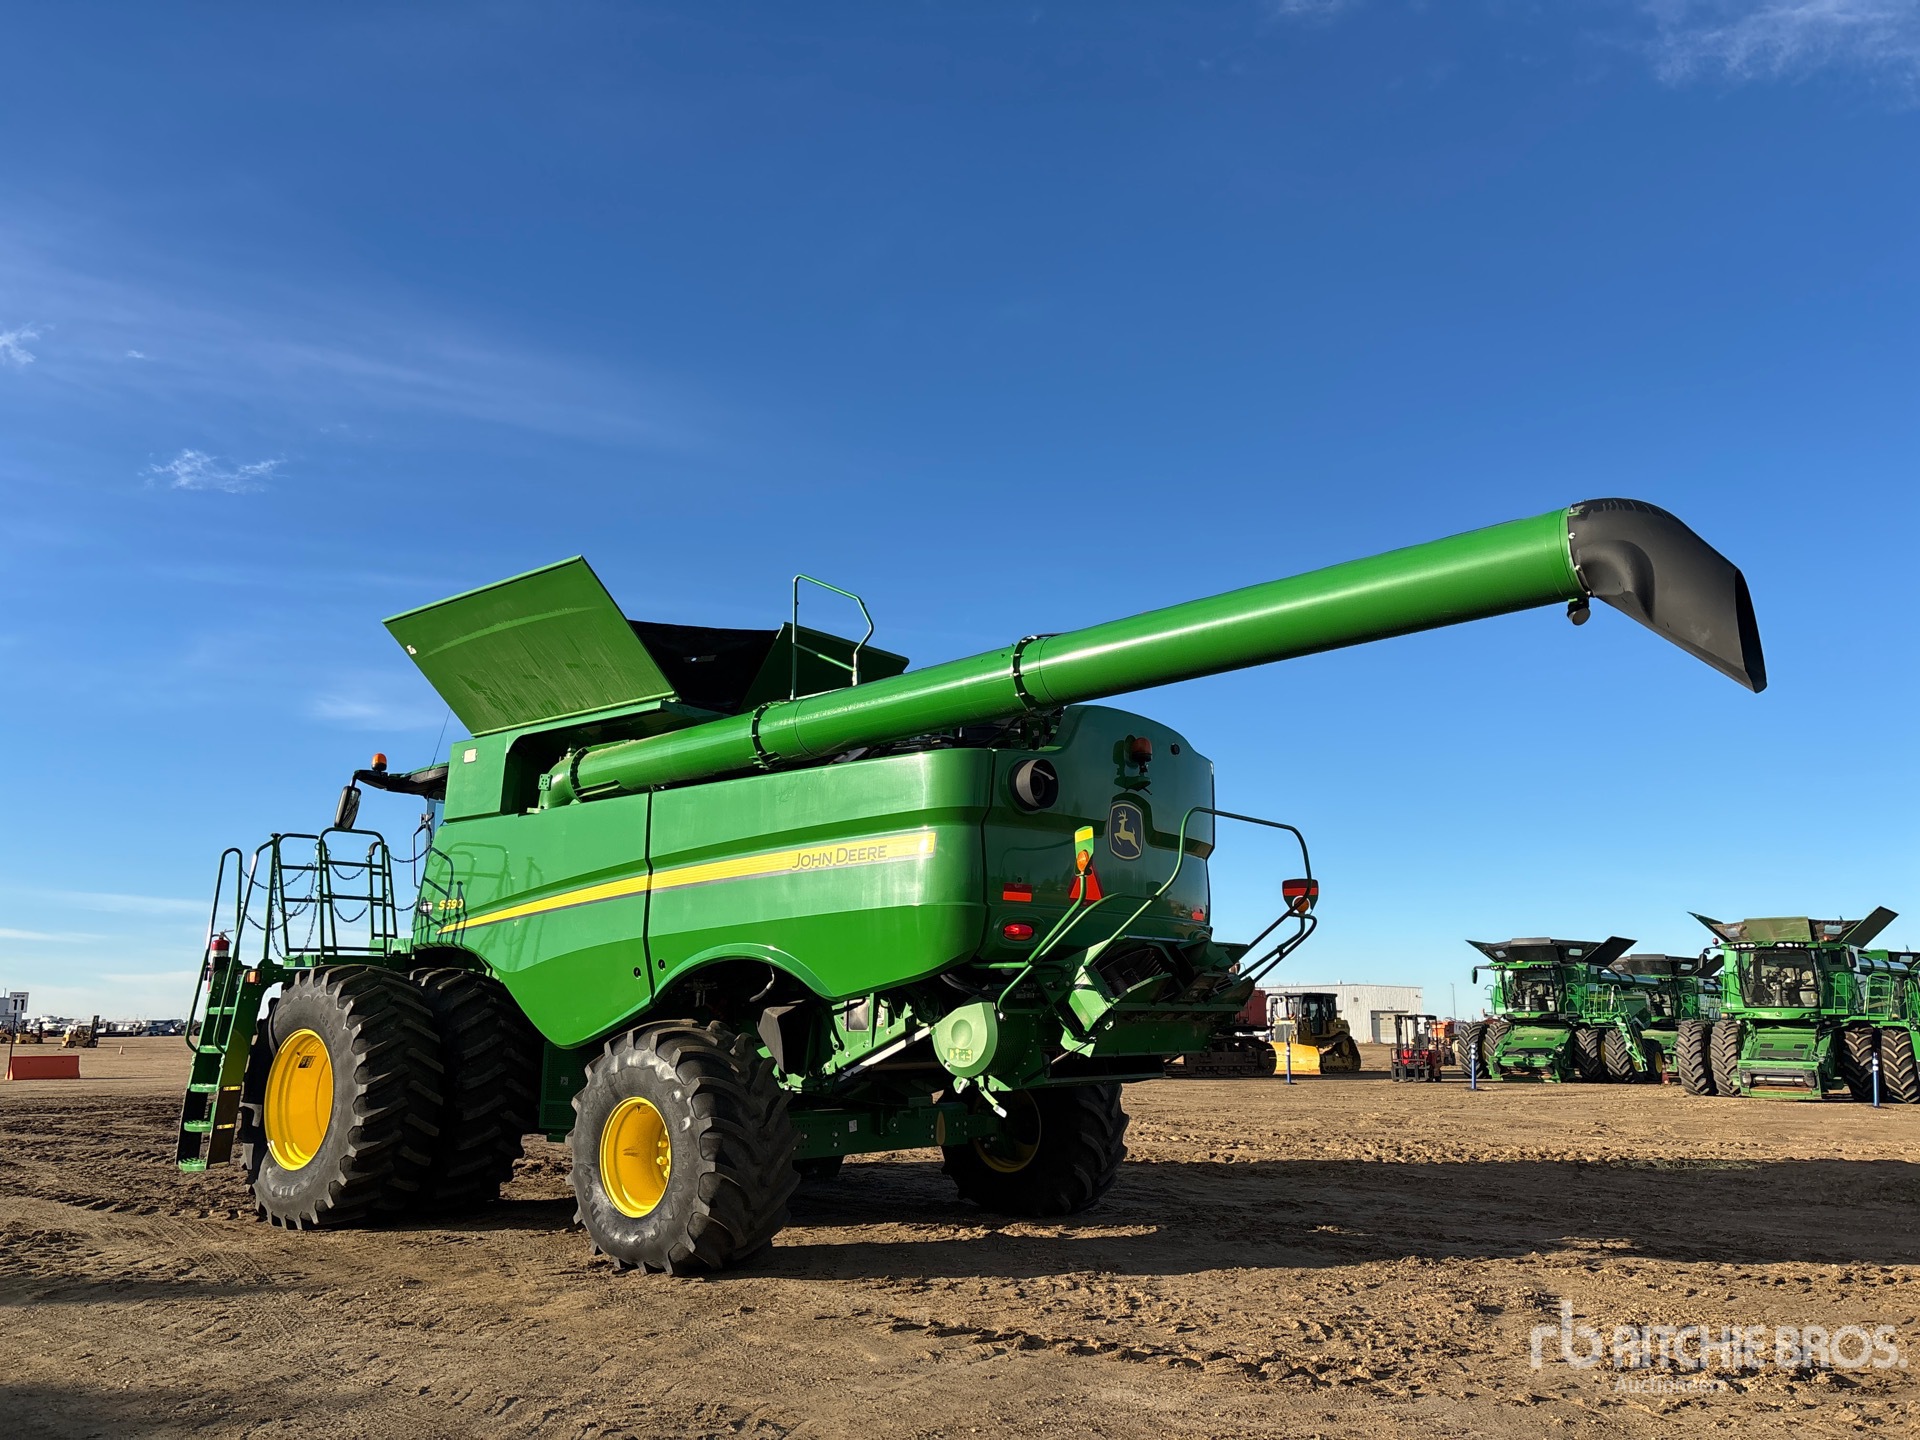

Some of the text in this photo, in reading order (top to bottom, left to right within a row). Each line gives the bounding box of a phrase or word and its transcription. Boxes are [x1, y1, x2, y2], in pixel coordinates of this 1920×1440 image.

[792, 845, 887, 868] JOHN DEERE
[13, 999, 25, 1010] 11
